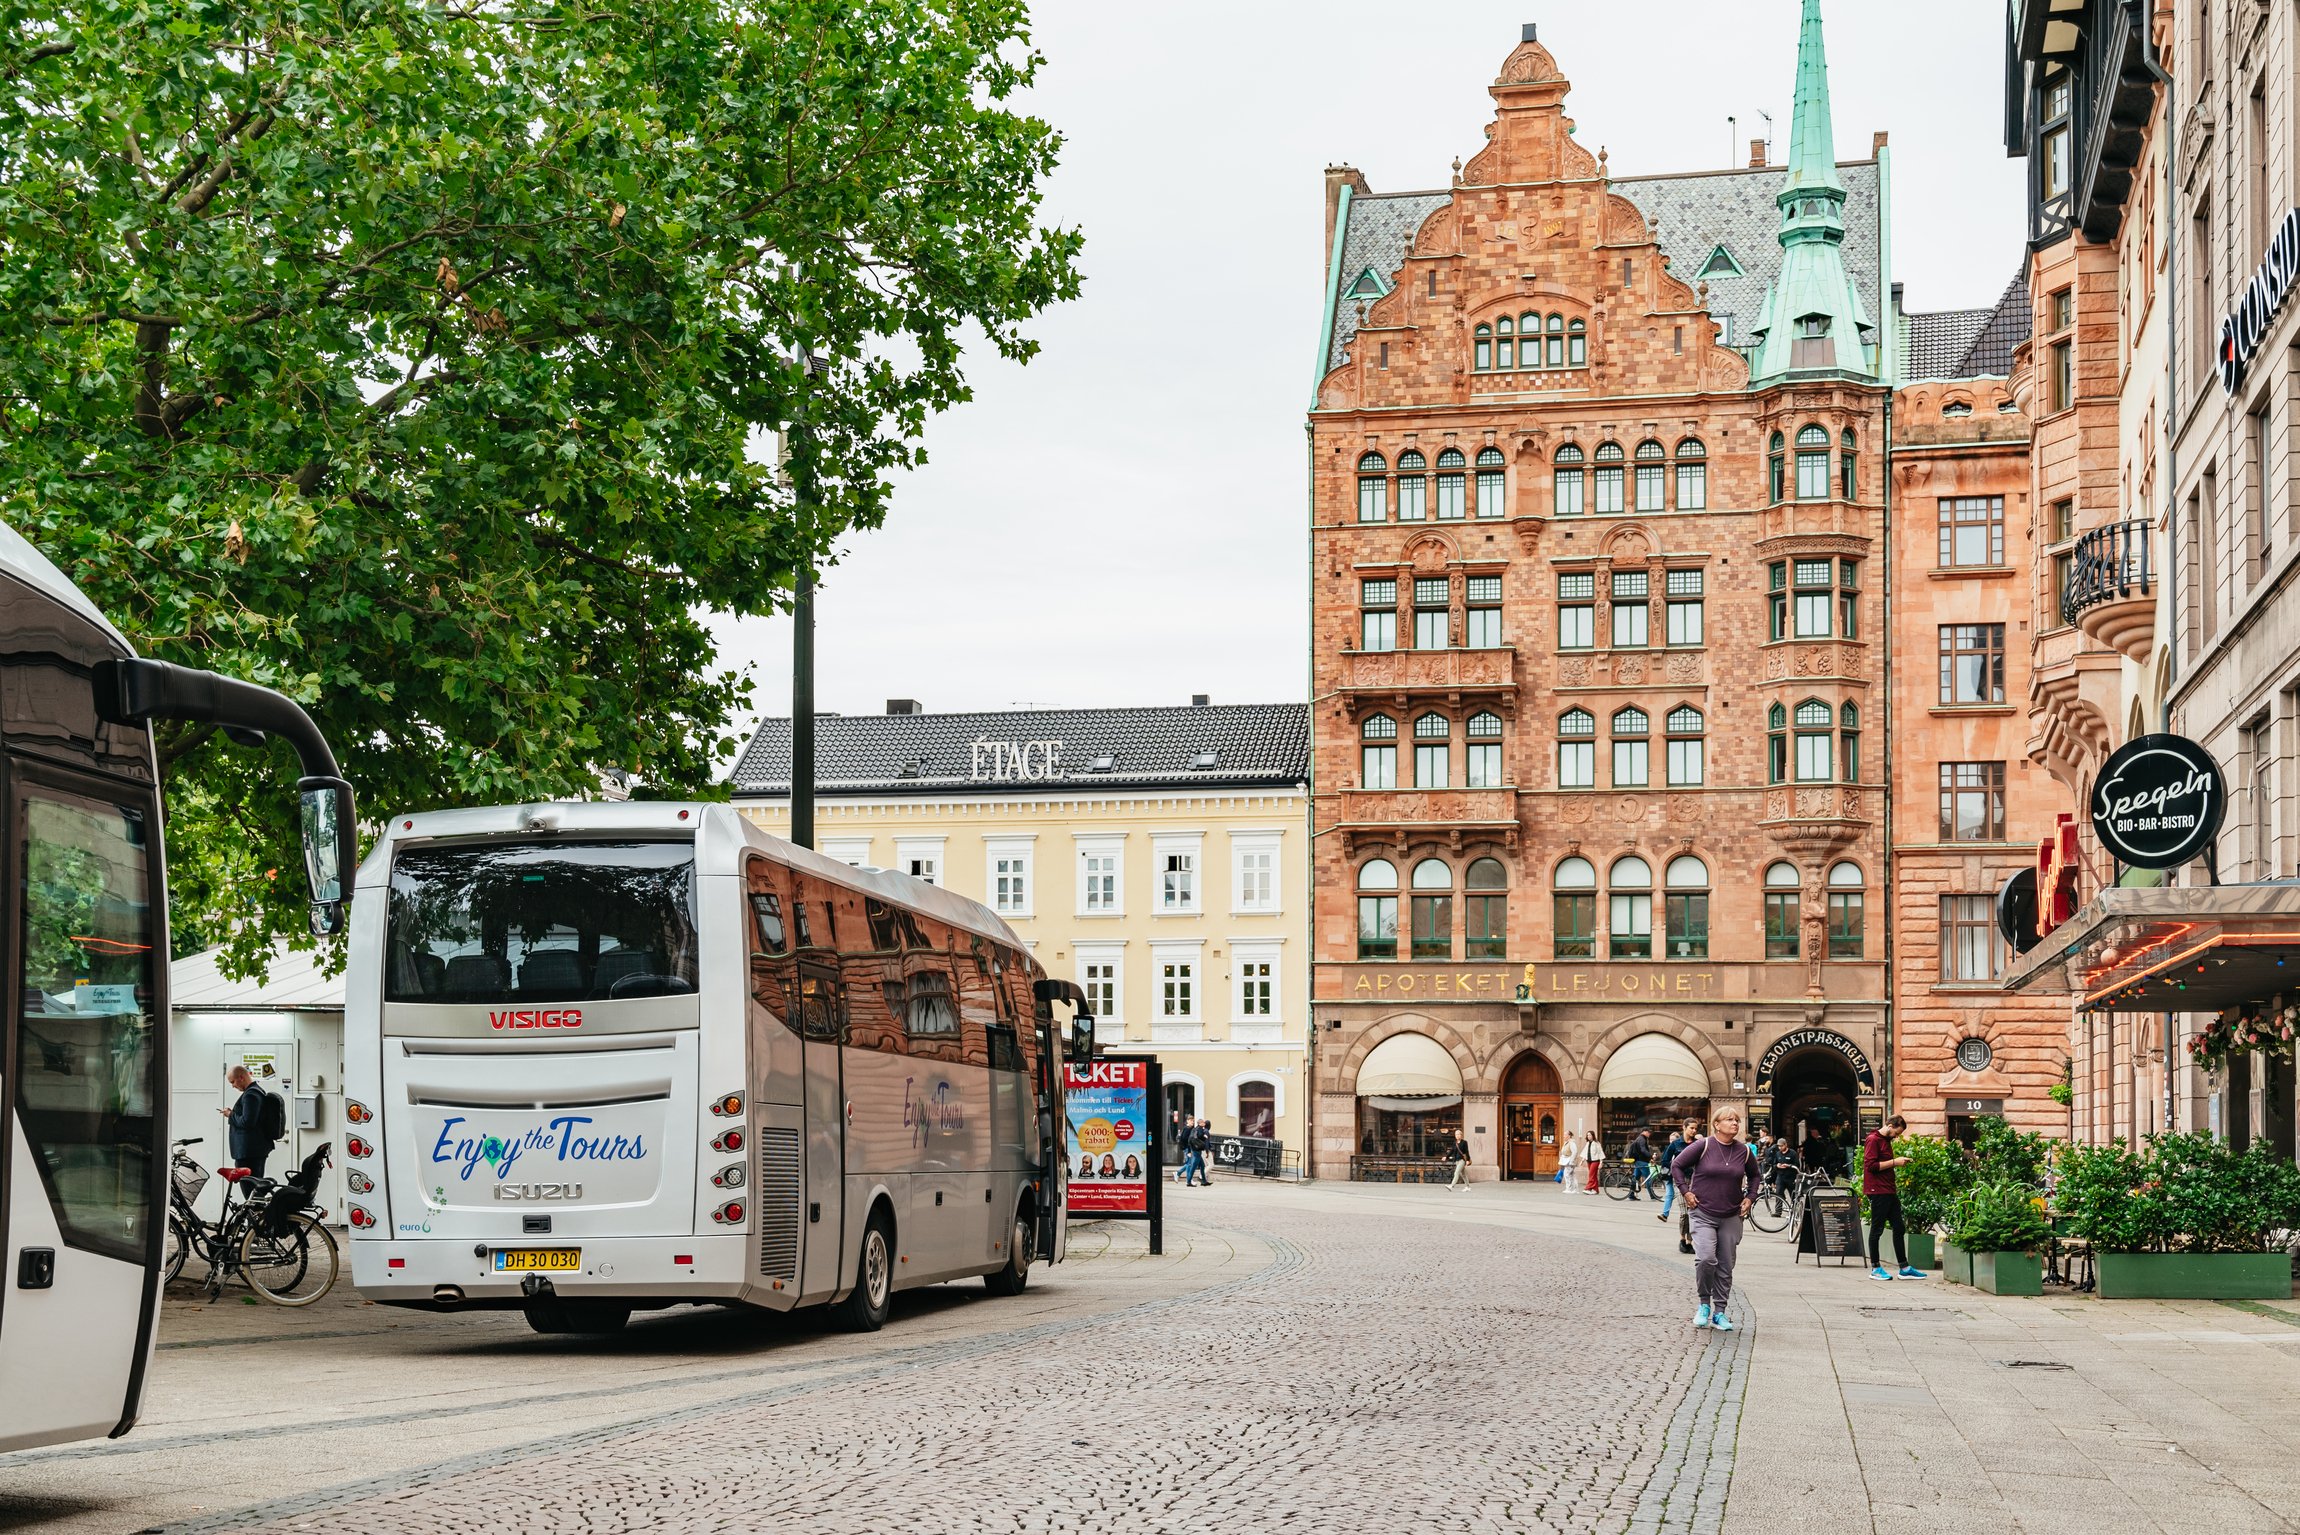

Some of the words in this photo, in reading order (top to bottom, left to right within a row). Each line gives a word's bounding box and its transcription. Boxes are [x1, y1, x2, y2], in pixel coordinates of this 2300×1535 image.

[2237, 207, 2299, 362] CONSID
[969, 735, 1065, 781] ÉTAGE
[2093, 769, 2212, 820] Spegeln
[2117, 819, 2133, 832] BIO
[2138, 817, 2157, 831] BAR
[2161, 814, 2195, 829] BISTRO
[1354, 973, 1511, 992] APOTEKET
[1552, 973, 1714, 992] LEJONET
[489, 1009, 582, 1030] VISIGO
[1760, 1031, 1869, 1075] LEJONETPASSAGEN
[1064, 1063, 1139, 1082] IKET
[1967, 1100, 1982, 1110] 10
[432, 1117, 522, 1181] Enjoy
[523, 1126, 555, 1150] the
[549, 1117, 648, 1161] Tours
[493, 1183, 583, 1200] ISUZU
[399, 1224, 420, 1232] euro
[506, 1253, 526, 1267] DH
[529, 1253, 547, 1267] 30
[551, 1252, 578, 1267] 030
